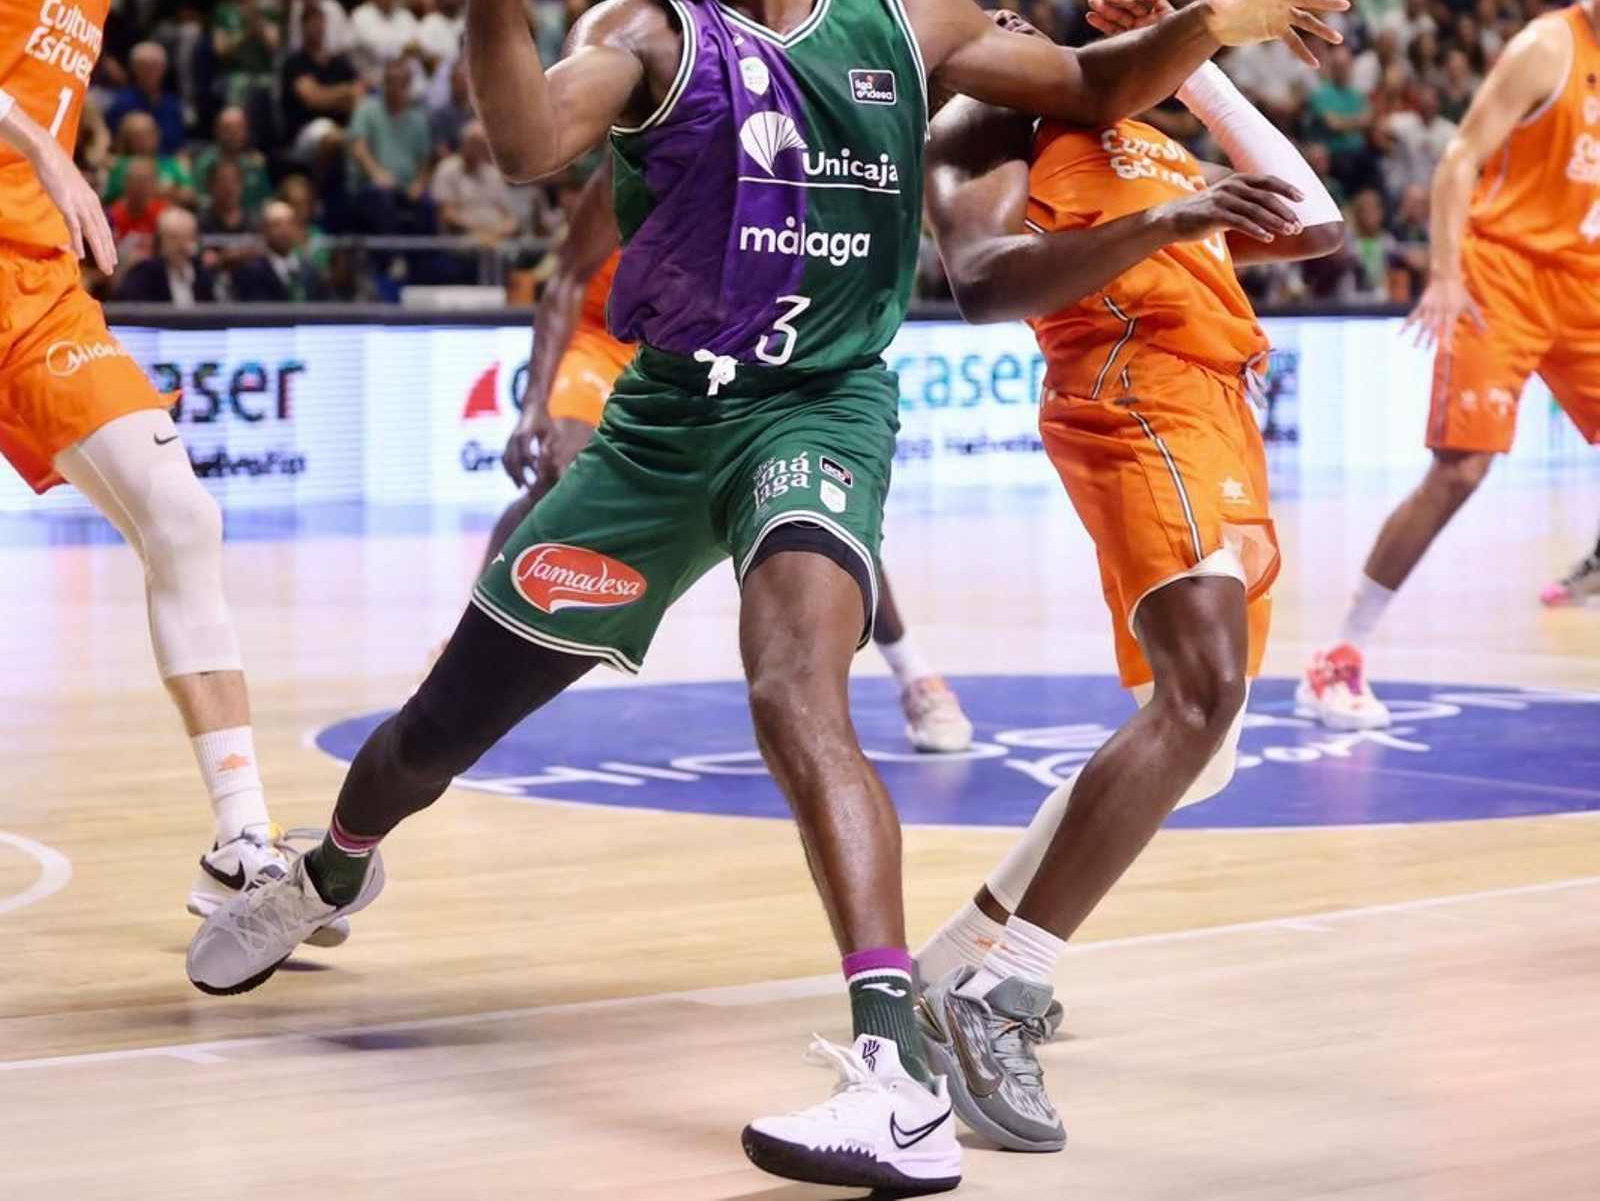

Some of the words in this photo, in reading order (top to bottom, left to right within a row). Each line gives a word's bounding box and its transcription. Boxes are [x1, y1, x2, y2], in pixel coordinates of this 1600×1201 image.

[50, 86, 73, 139] 1
[802, 148, 899, 187] Unicaja
[755, 294, 812, 367] 3
[152, 359, 305, 424] aser
[518, 548, 640, 597] famadesa
